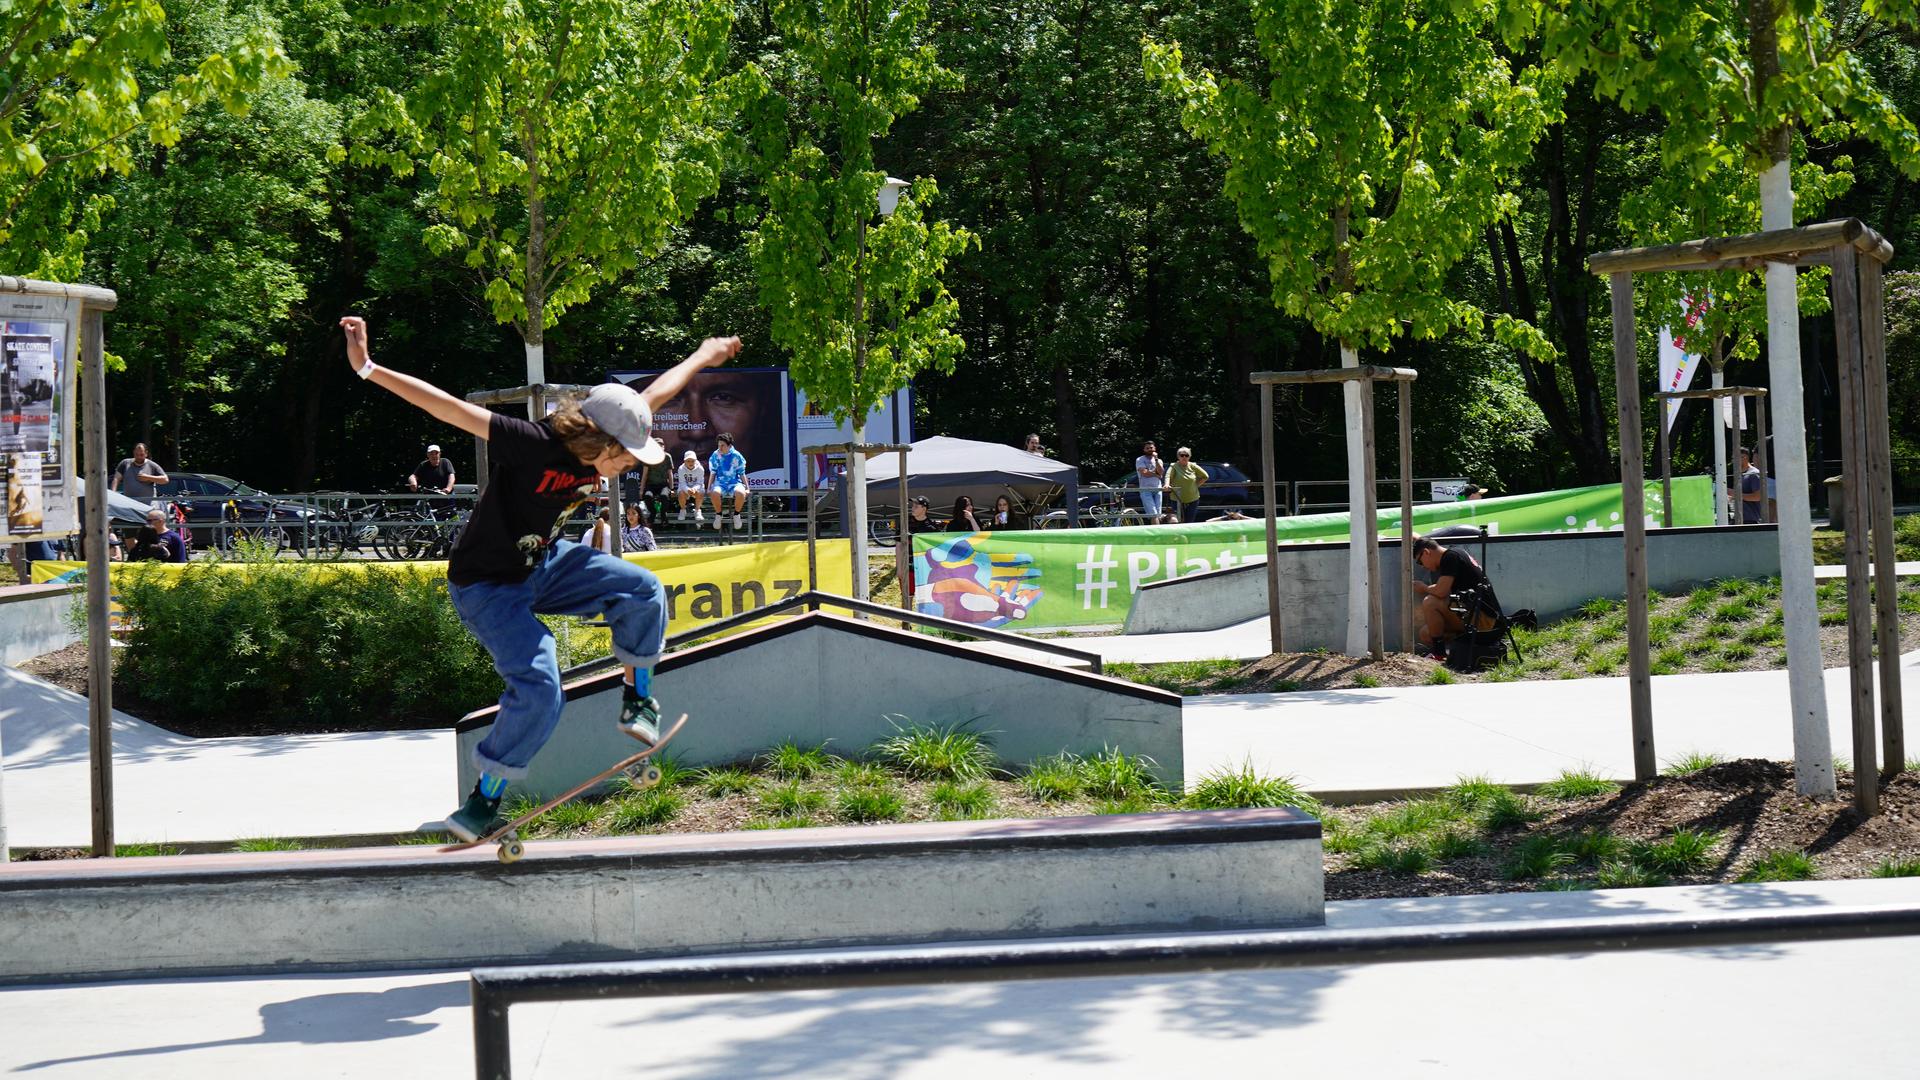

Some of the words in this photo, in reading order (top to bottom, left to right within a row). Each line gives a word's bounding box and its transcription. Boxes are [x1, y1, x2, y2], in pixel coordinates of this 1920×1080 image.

[652, 413, 689, 422] treibung
[661, 422, 707, 430] Menschen?
[748, 478, 780, 486] isereor
[665, 579, 804, 620] ranz
